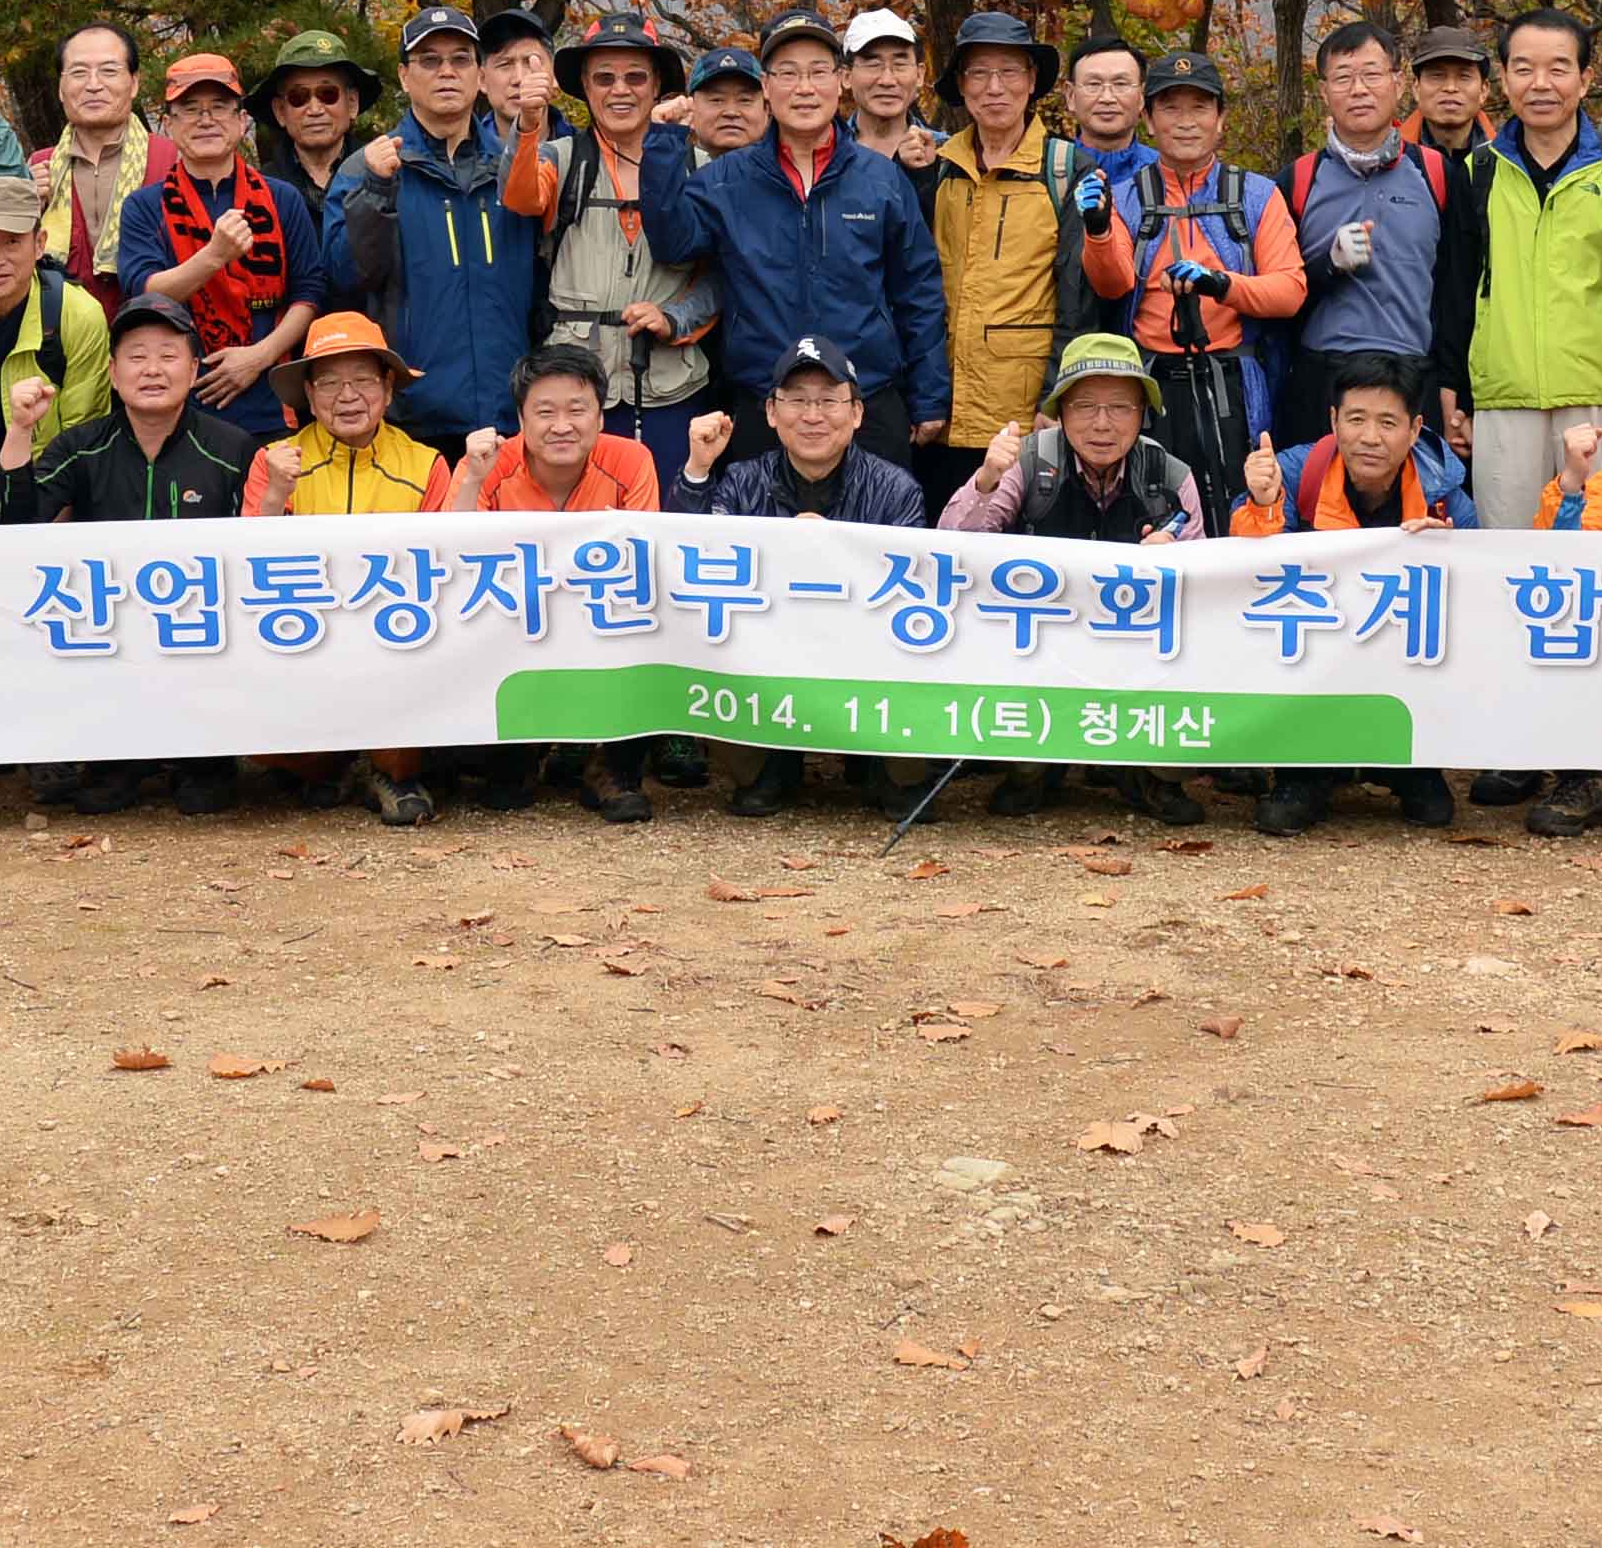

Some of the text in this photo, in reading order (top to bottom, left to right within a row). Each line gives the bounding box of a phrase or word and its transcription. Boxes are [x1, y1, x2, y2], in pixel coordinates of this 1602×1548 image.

[1243, 564, 1443, 660] 추계
[688, 683, 1216, 748] 2014. 11. 1(토) 청계산
